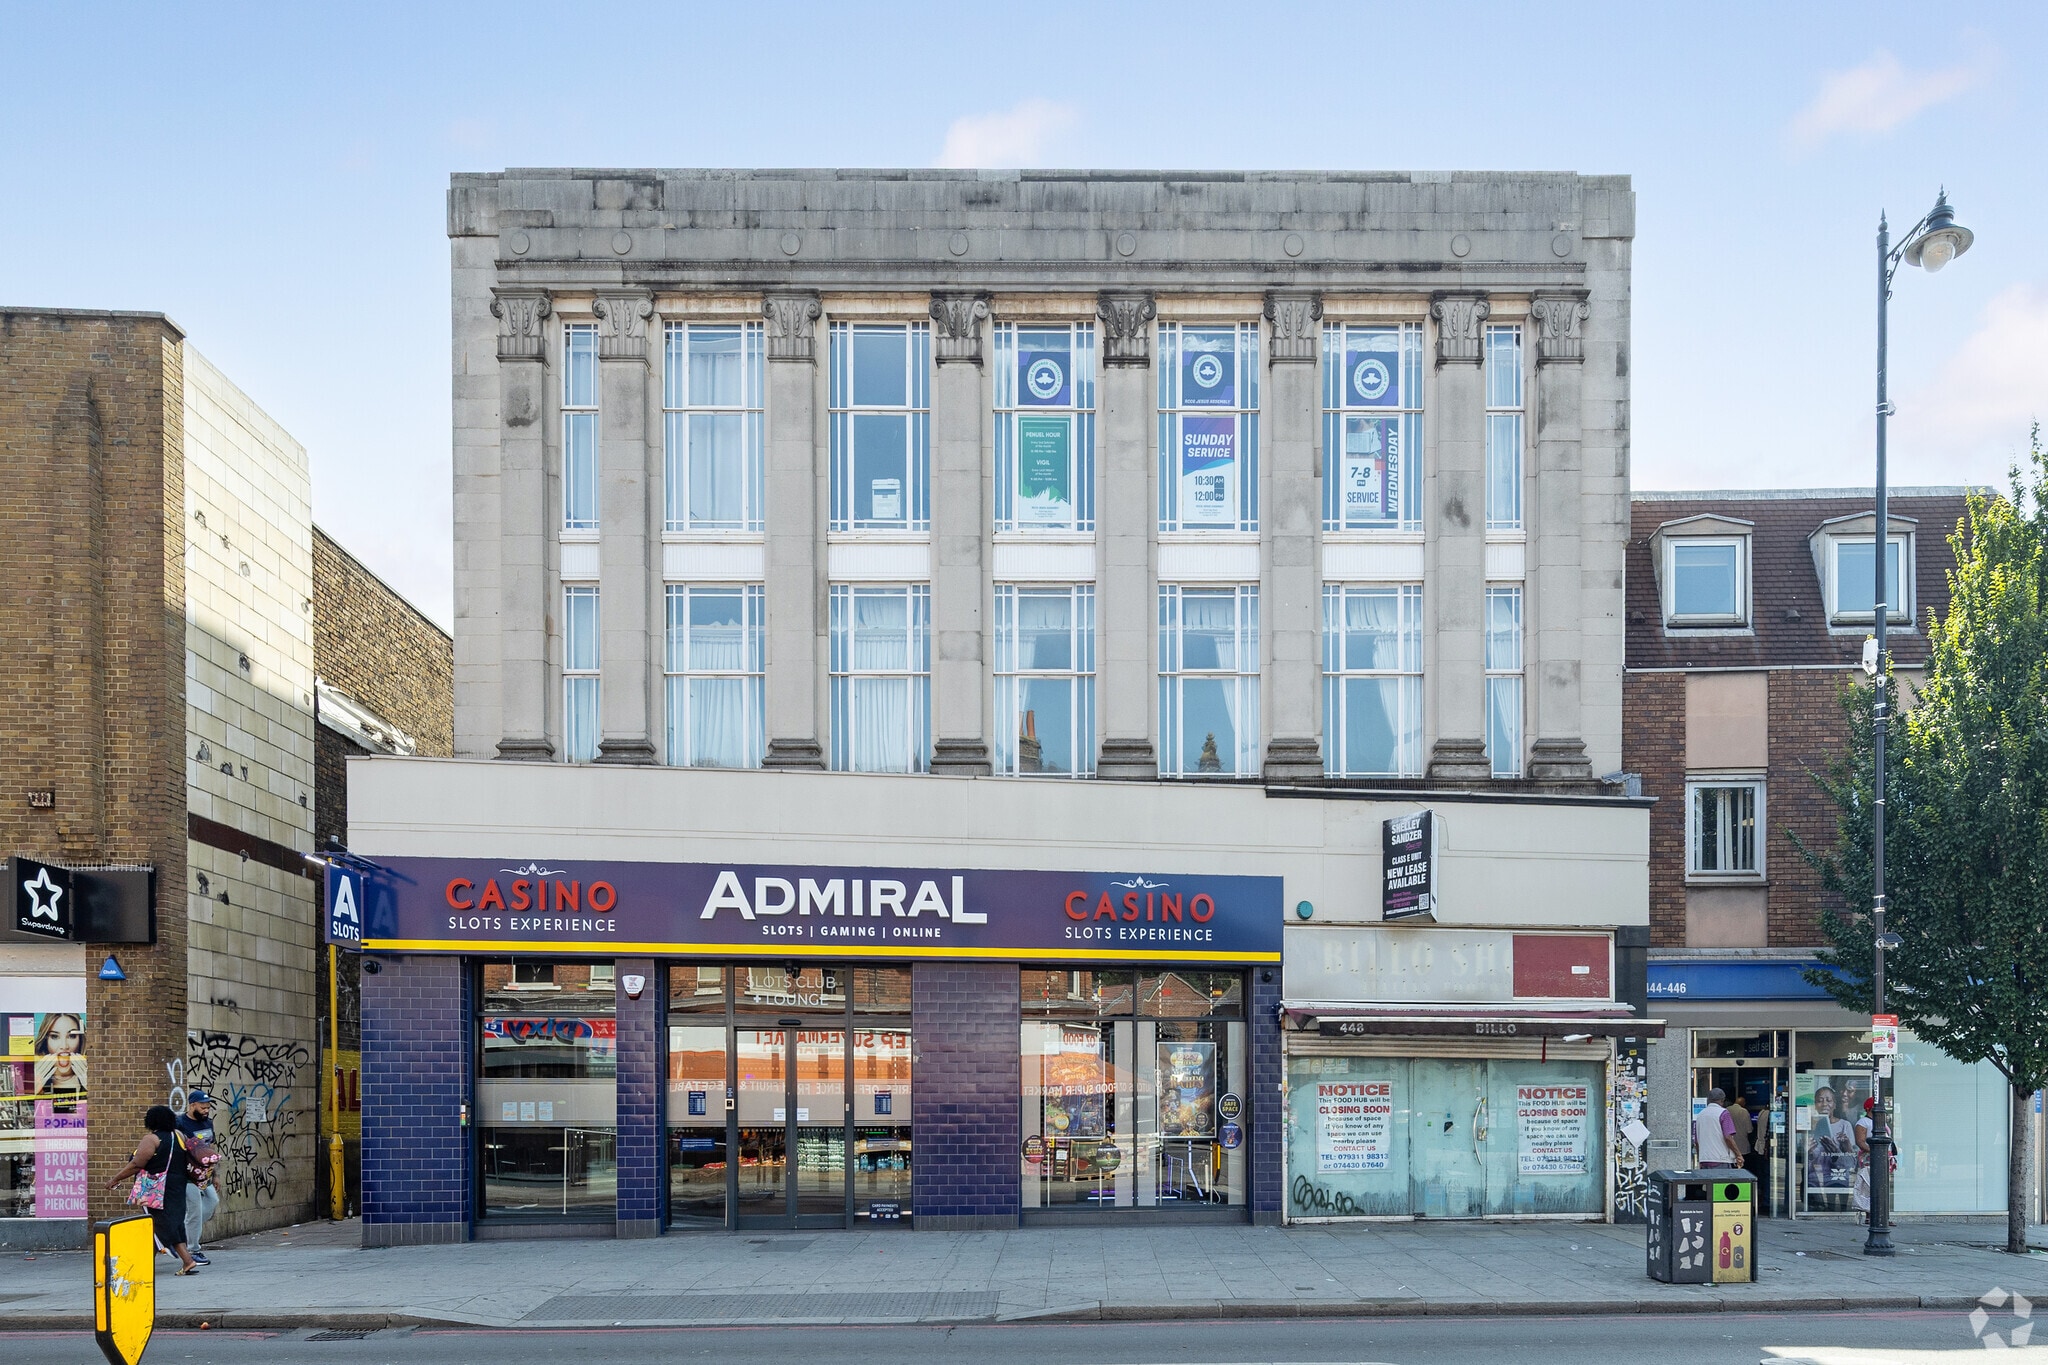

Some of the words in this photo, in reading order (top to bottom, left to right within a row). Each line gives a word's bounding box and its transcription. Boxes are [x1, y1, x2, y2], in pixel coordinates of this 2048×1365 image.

[1184, 434, 1234, 446] SUNDAY
[1188, 448, 1231, 458] SERVICE
[1350, 466, 1371, 478] 7-8
[1388, 428, 1398, 512] WEDNESDAY
[1194, 476, 1214, 486] 10:30
[1194, 491, 1214, 501] 12:00
[1346, 492, 1379, 503] SERVICE
[1391, 818, 1420, 835] SHELLEY
[1391, 830, 1422, 846] SANDZER
[1392, 854, 1406, 866] CLASS
[1411, 852, 1422, 862] UNIT
[1387, 866, 1404, 880] NEW
[1404, 862, 1428, 876] LEASE
[1388, 873, 1426, 890] AVAILABLE
[332, 874, 359, 924] A
[445, 876, 618, 912] CASINO
[700, 870, 988, 925] ADMIRAL
[1064, 890, 1215, 924] CASINO
[22, 918, 66, 935] Superdrug
[448, 916, 502, 931] SLOTS
[510, 918, 616, 932] EXPERIENCE
[332, 920, 360, 942] SLOTS
[762, 925, 804, 936] SLOTS
[820, 926, 876, 938] GAMING
[893, 927, 942, 938] ONLINE
[1065, 927, 1112, 940] SLOTS
[1120, 928, 1213, 942] EXPERIENCE
[746, 976, 791, 989] SLOTS
[796, 976, 836, 989] CLUB
[766, 993, 829, 1006] LOUNGE
[1476, 1023, 1516, 1034] BILLO
[1319, 1085, 1389, 1096] NOTICE
[1519, 1088, 1586, 1099] NOTICE
[44, 1118, 85, 1128] POP-IN
[44, 1140, 86, 1150] THREADING
[44, 1153, 85, 1166] BROWS
[44, 1168, 85, 1181] LASH
[44, 1184, 85, 1195] NAILS
[44, 1198, 86, 1211] PIERCING
